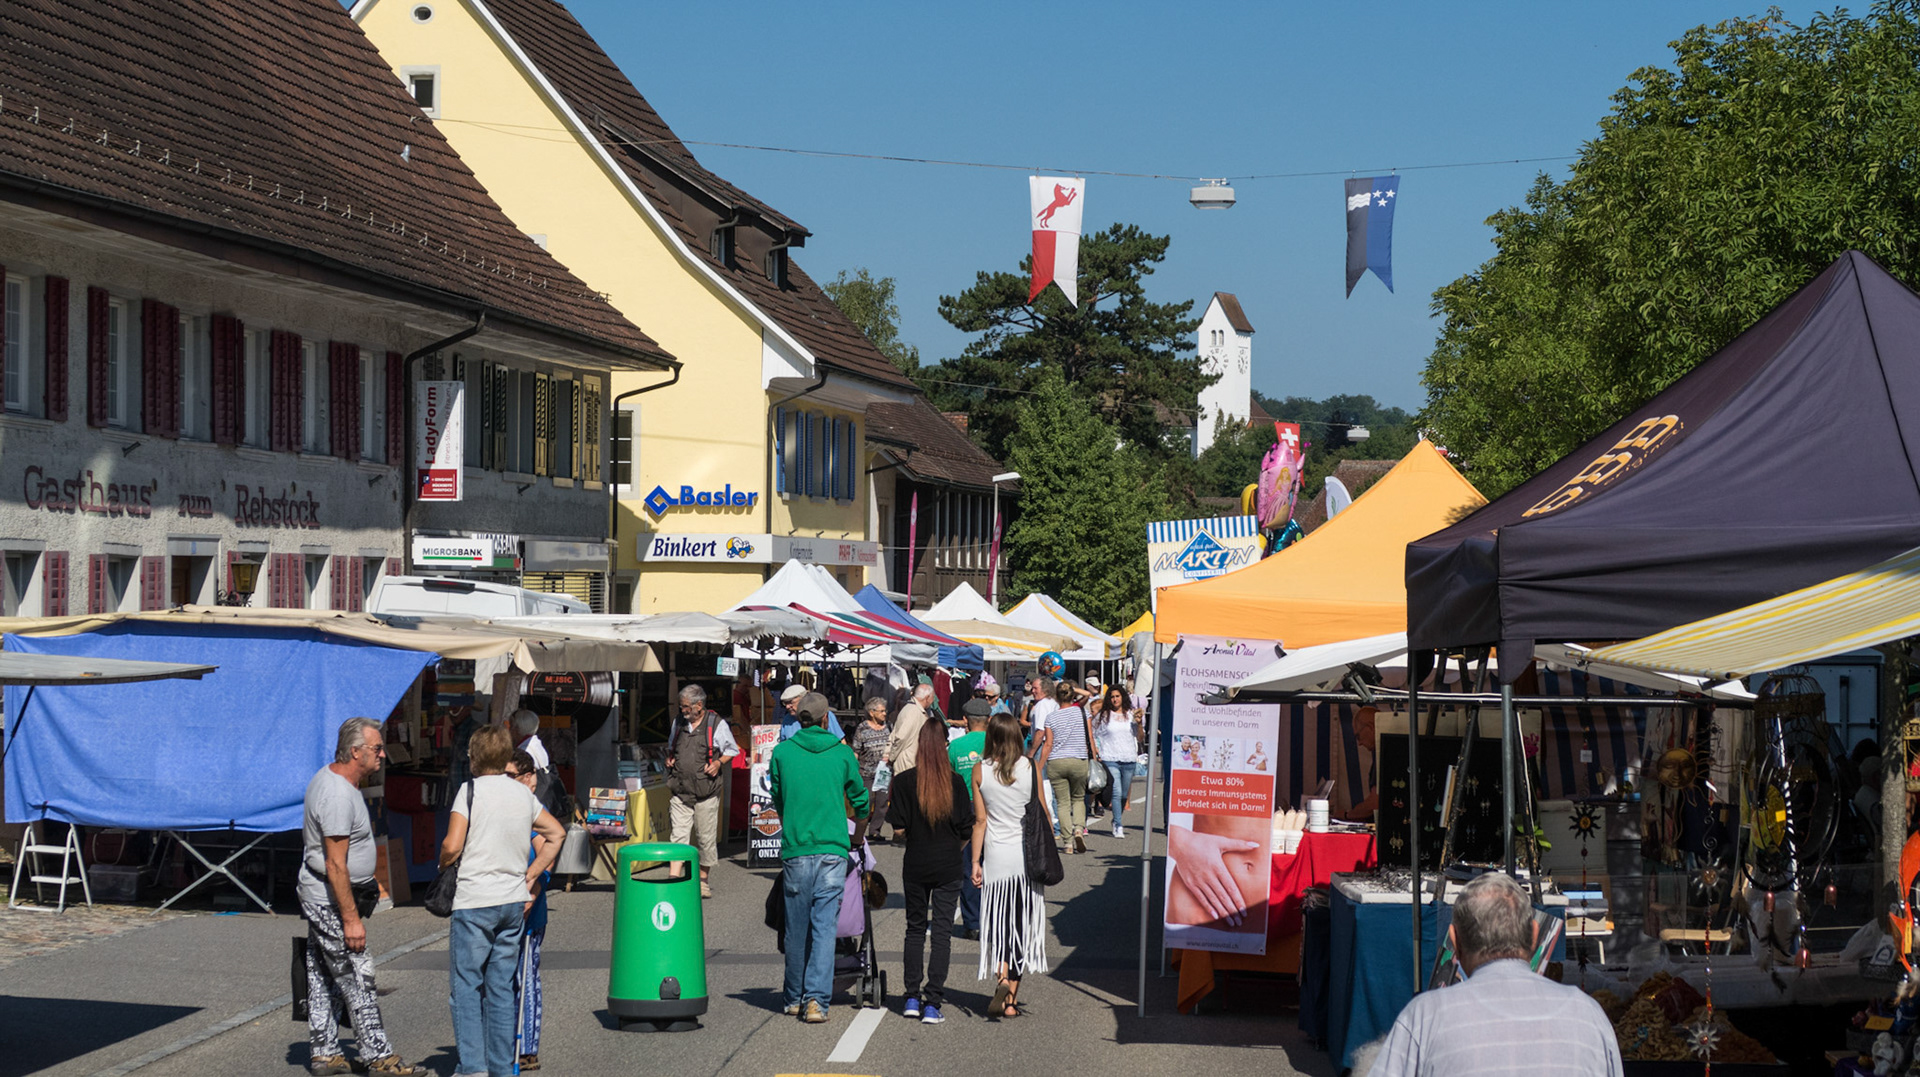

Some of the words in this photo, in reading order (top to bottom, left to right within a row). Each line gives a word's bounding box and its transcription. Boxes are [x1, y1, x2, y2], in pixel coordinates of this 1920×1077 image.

[425, 386, 439, 464] LadyForm
[24, 465, 153, 518] Gasthaus
[178, 493, 214, 518] zum
[235, 485, 321, 528] Rebstock
[680, 484, 758, 507] Basler
[422, 547, 483, 556] MIGROSBANK
[653, 537, 717, 557] Binkert
[1153, 545, 1255, 572] MARTIN
[1235, 643, 1257, 656] Vital
[1191, 706, 1207, 715] und
[1208, 707, 1262, 718] Wohlbefinden
[1192, 717, 1200, 726] in
[1202, 720, 1235, 728] unserem
[1237, 720, 1260, 729] Darm
[1201, 775, 1223, 786] Etwa
[1225, 777, 1245, 787] 80%
[1177, 788, 1207, 797] unseres
[1209, 789, 1267, 801] Immunsystems
[1177, 799, 1210, 809] befindet
[1211, 800, 1228, 810] sich
[1229, 801, 1239, 810] im
[1241, 803, 1266, 812] Darm!
[751, 839, 782, 849] PARKIN
[758, 848, 780, 859] ONLY
